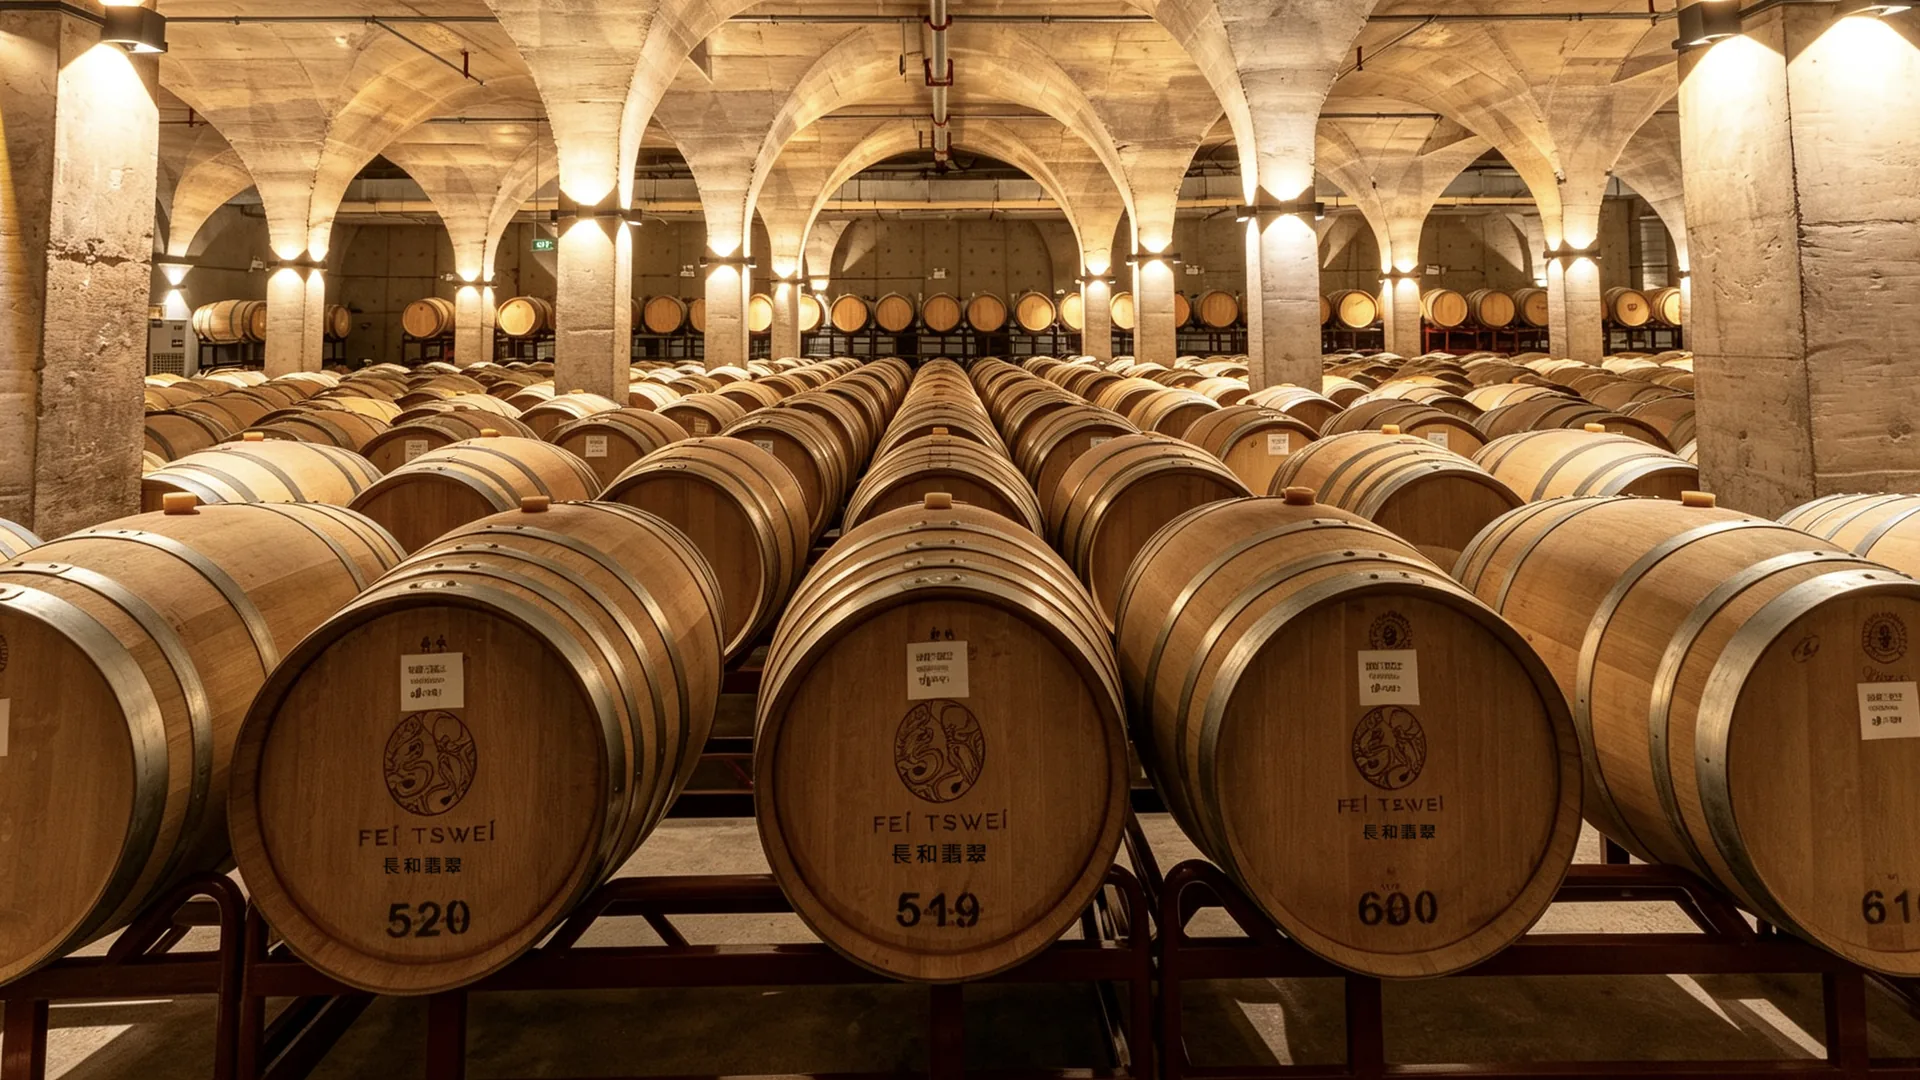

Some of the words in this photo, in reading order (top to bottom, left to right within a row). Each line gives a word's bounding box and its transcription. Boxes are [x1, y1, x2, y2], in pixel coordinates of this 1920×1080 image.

[1362, 824, 1436, 840] 長和翡翠
[383, 857, 462, 875] 長和翡翠
[891, 843, 987, 864] 長和翡翠
[386, 899, 471, 939] 520
[896, 891, 980, 929] 519
[1862, 889, 1920, 925] 61
